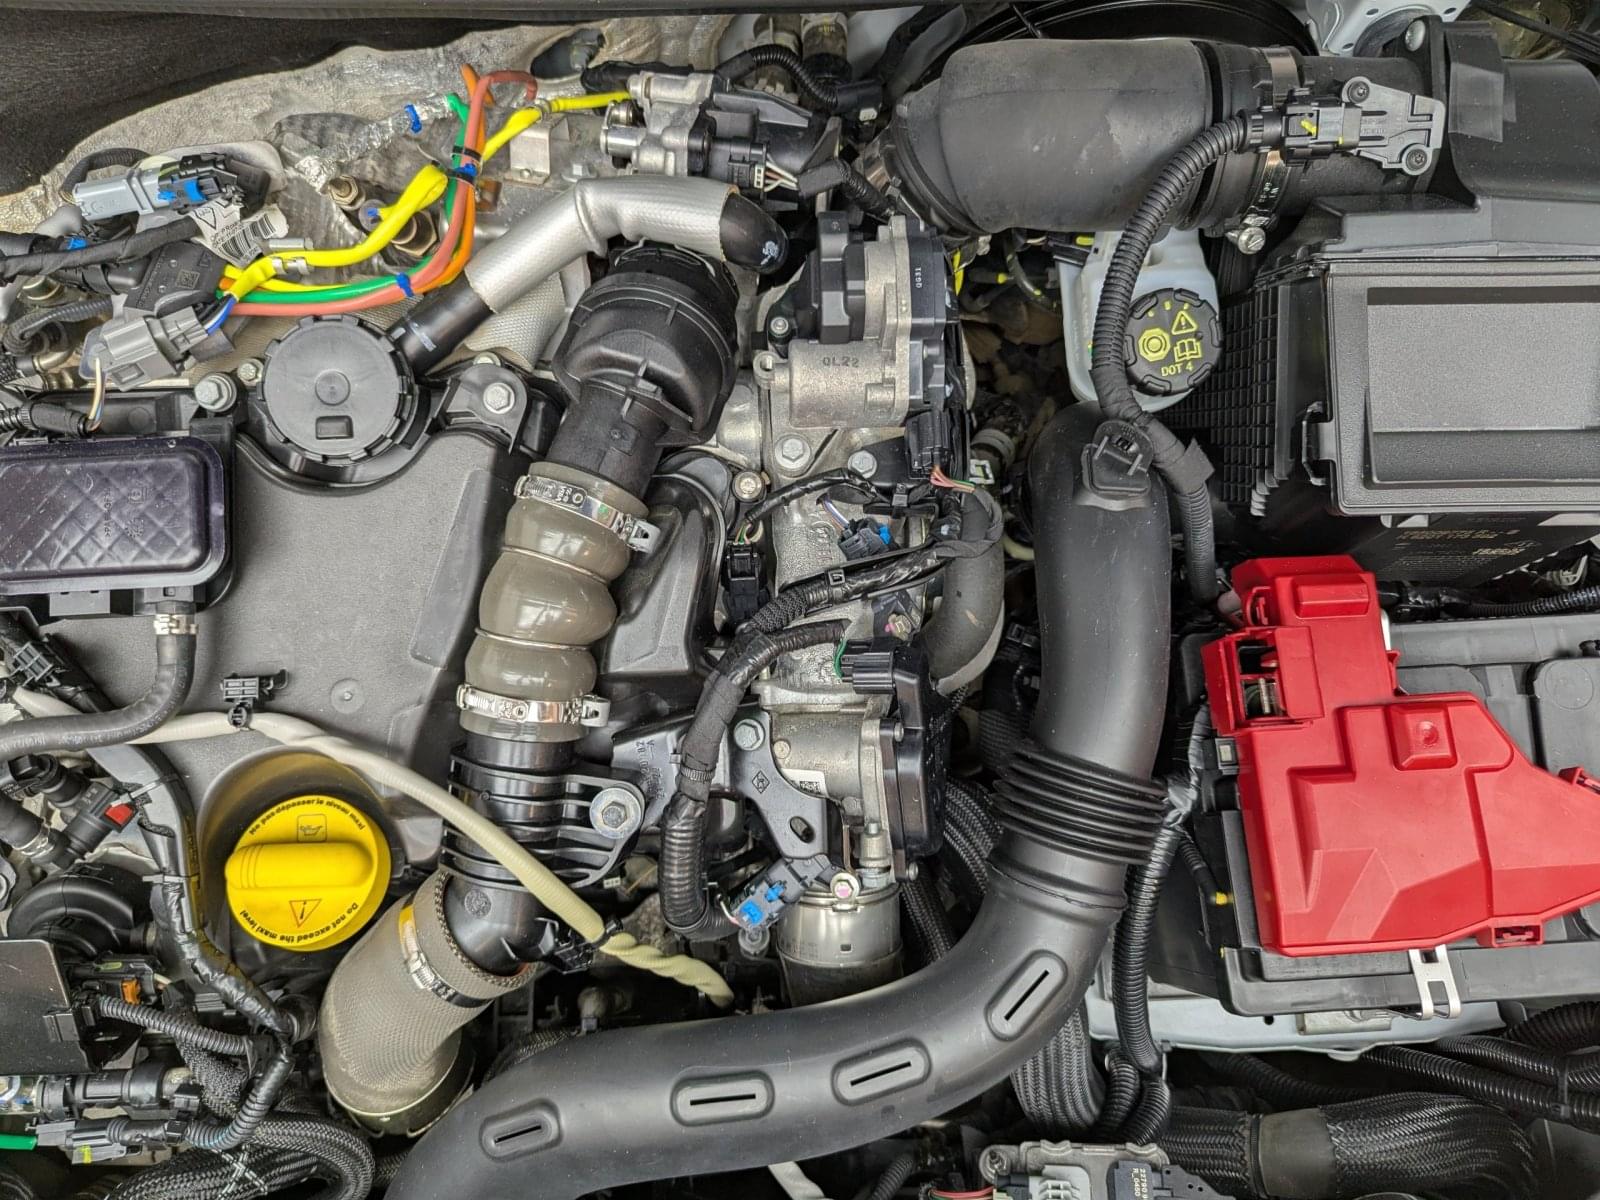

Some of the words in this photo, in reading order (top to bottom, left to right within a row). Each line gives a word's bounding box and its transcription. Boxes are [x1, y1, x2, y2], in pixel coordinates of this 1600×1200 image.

[1161, 362, 1183, 376] DOT
[1186, 361, 1193, 371] 4
[249, 823, 261, 836] Ne
[261, 810, 276, 825] pas
[315, 797, 325, 805] le
[325, 800, 350, 815] niveau
[349, 812, 366, 830] maxi
[346, 902, 359, 914] Do
[239, 909, 257, 928] level
[331, 914, 346, 927] not
[256, 926, 278, 939] maxi
[279, 933, 295, 943] the
[297, 926, 331, 943] exceed
